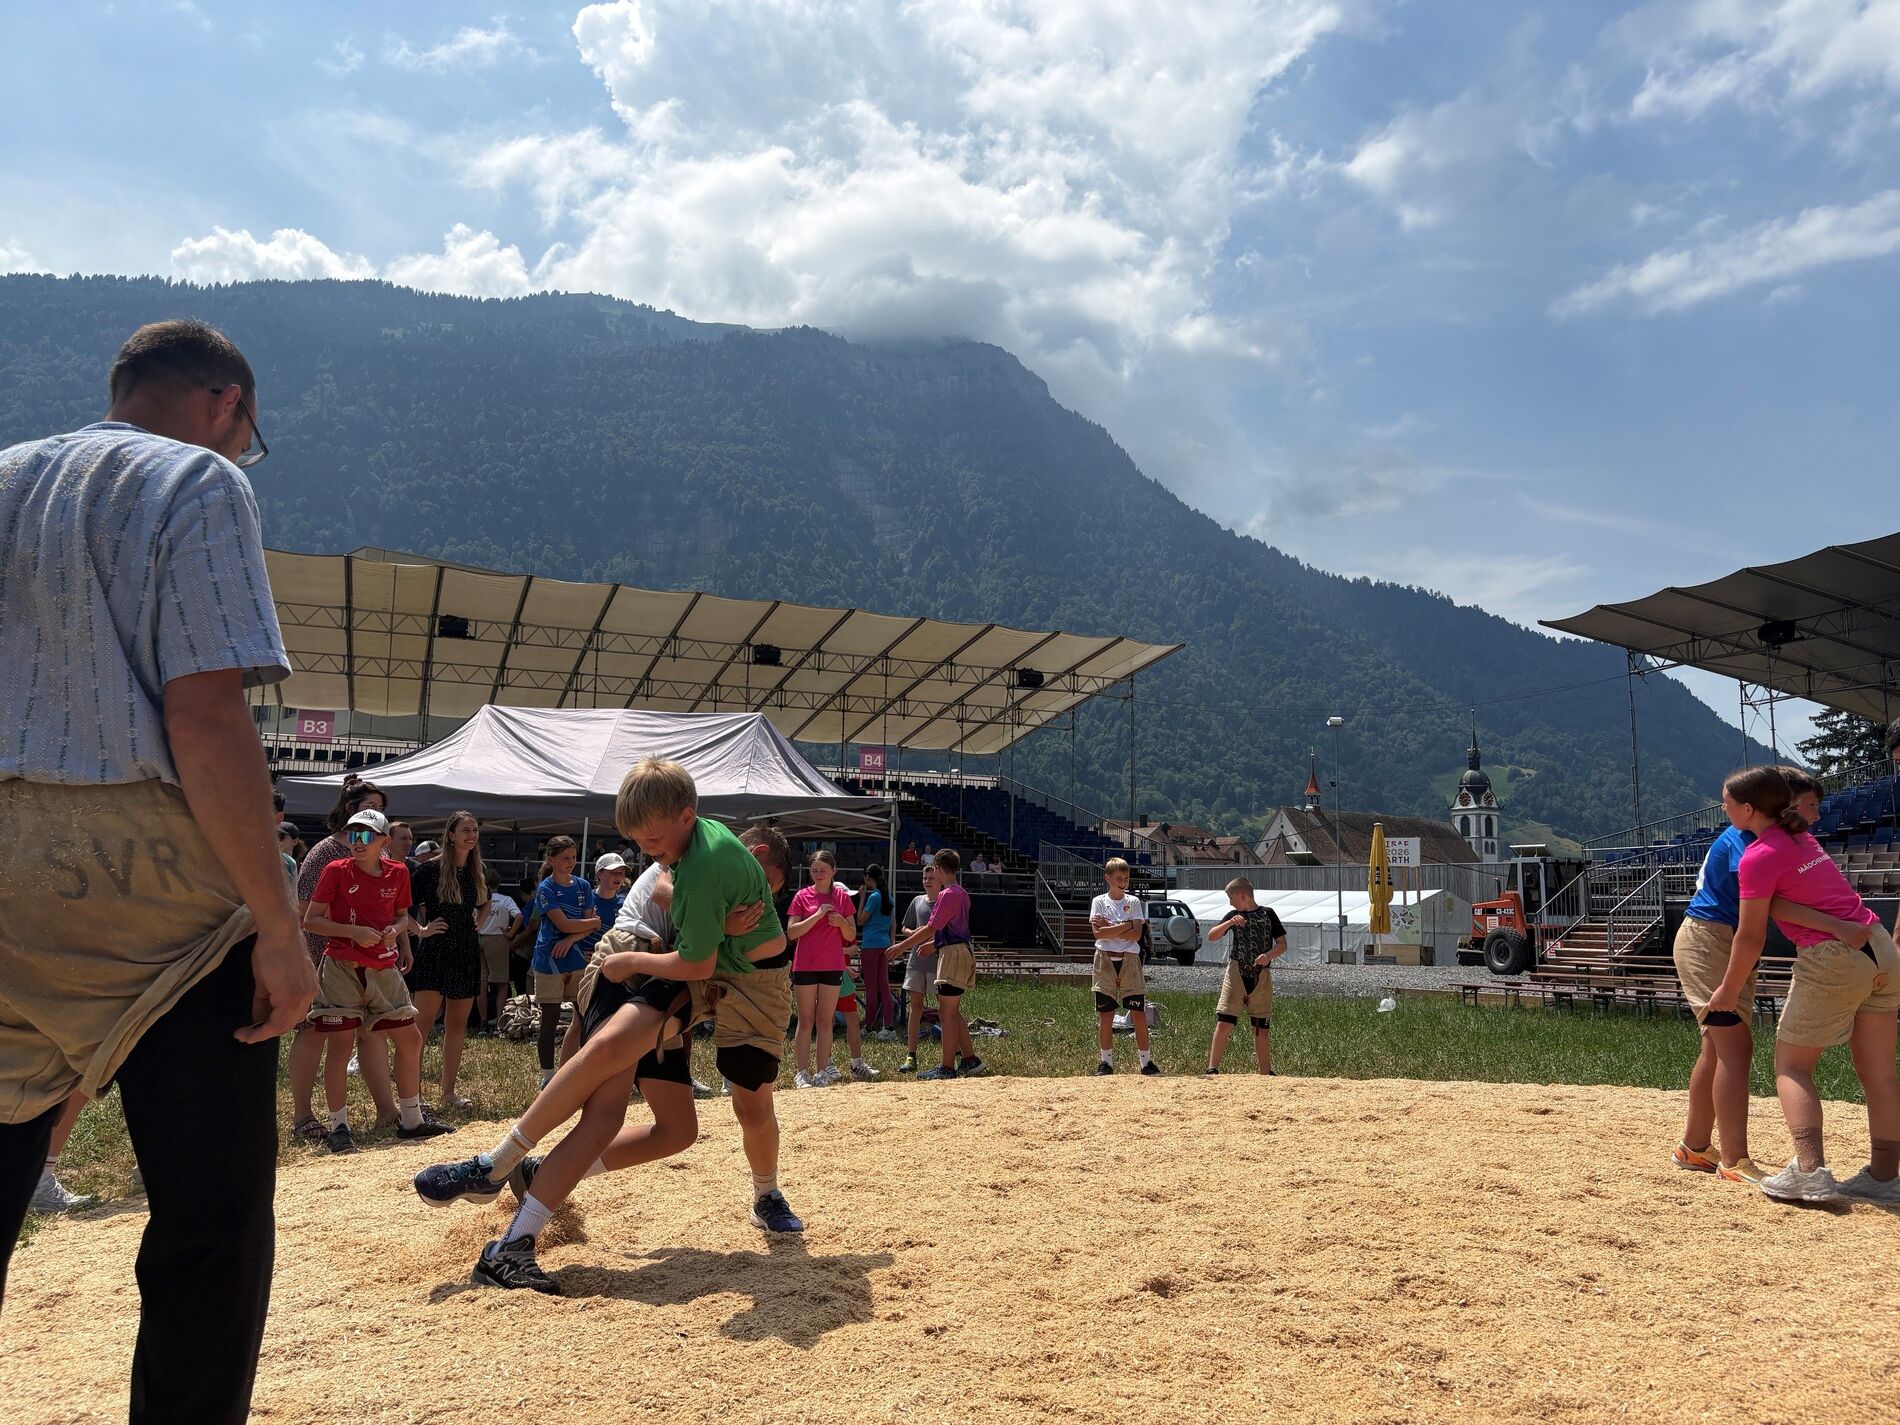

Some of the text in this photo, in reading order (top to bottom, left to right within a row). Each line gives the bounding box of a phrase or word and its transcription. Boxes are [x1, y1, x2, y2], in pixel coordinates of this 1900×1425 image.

[303, 719, 327, 734] B3
[864, 754, 882, 768] B4
[1385, 848, 1410, 856] 2026
[45, 837, 195, 900] SVR
[1474, 908, 1483, 916] CAT
